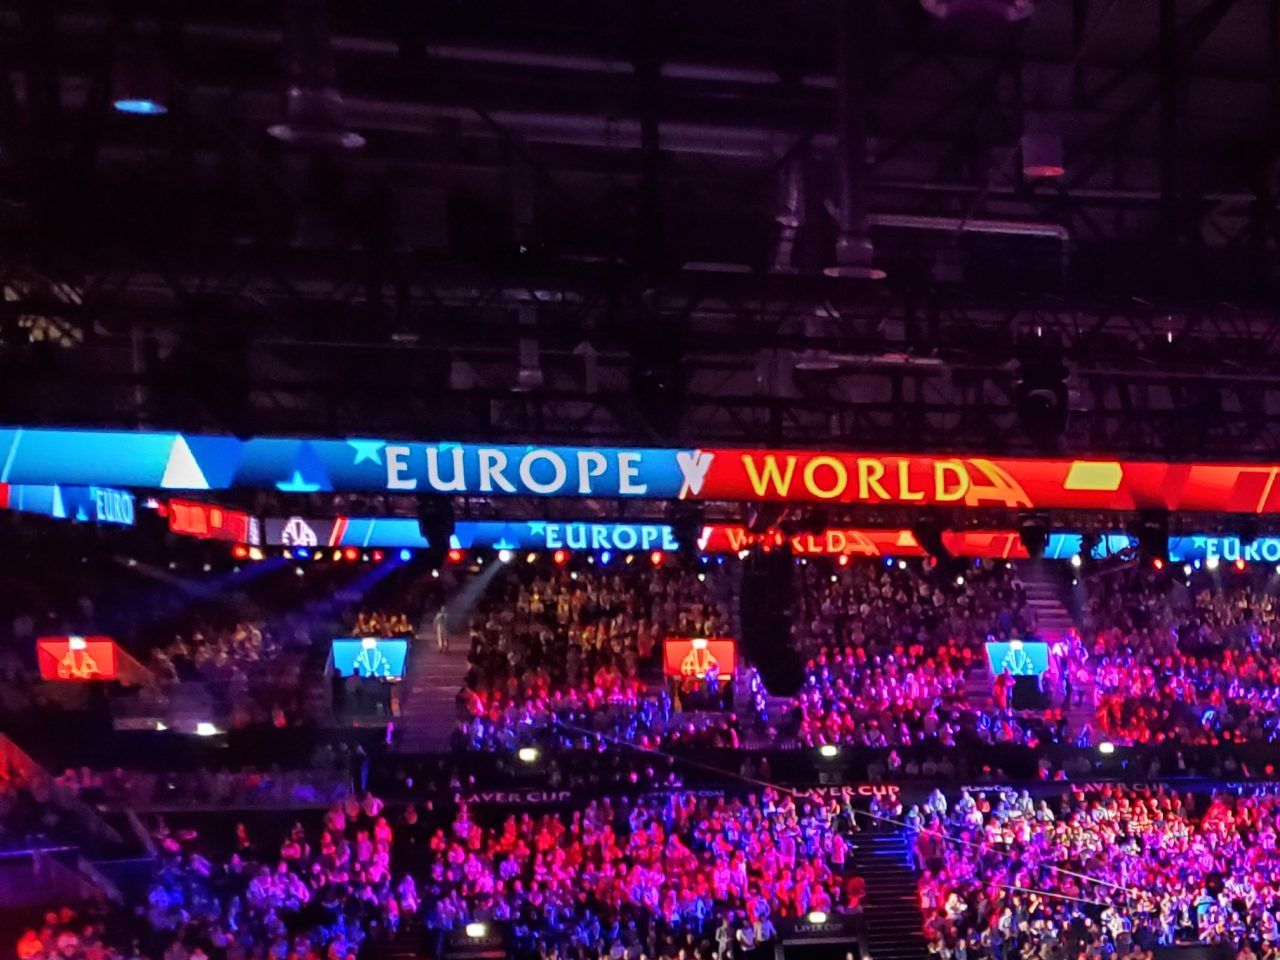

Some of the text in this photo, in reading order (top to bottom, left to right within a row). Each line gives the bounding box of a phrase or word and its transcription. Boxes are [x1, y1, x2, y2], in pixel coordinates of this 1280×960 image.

[385, 446, 648, 494] EUROPE
[741, 454, 971, 501] WORLD
[545, 524, 679, 550] EUROPE
[792, 784, 901, 798] LAVER CUP
